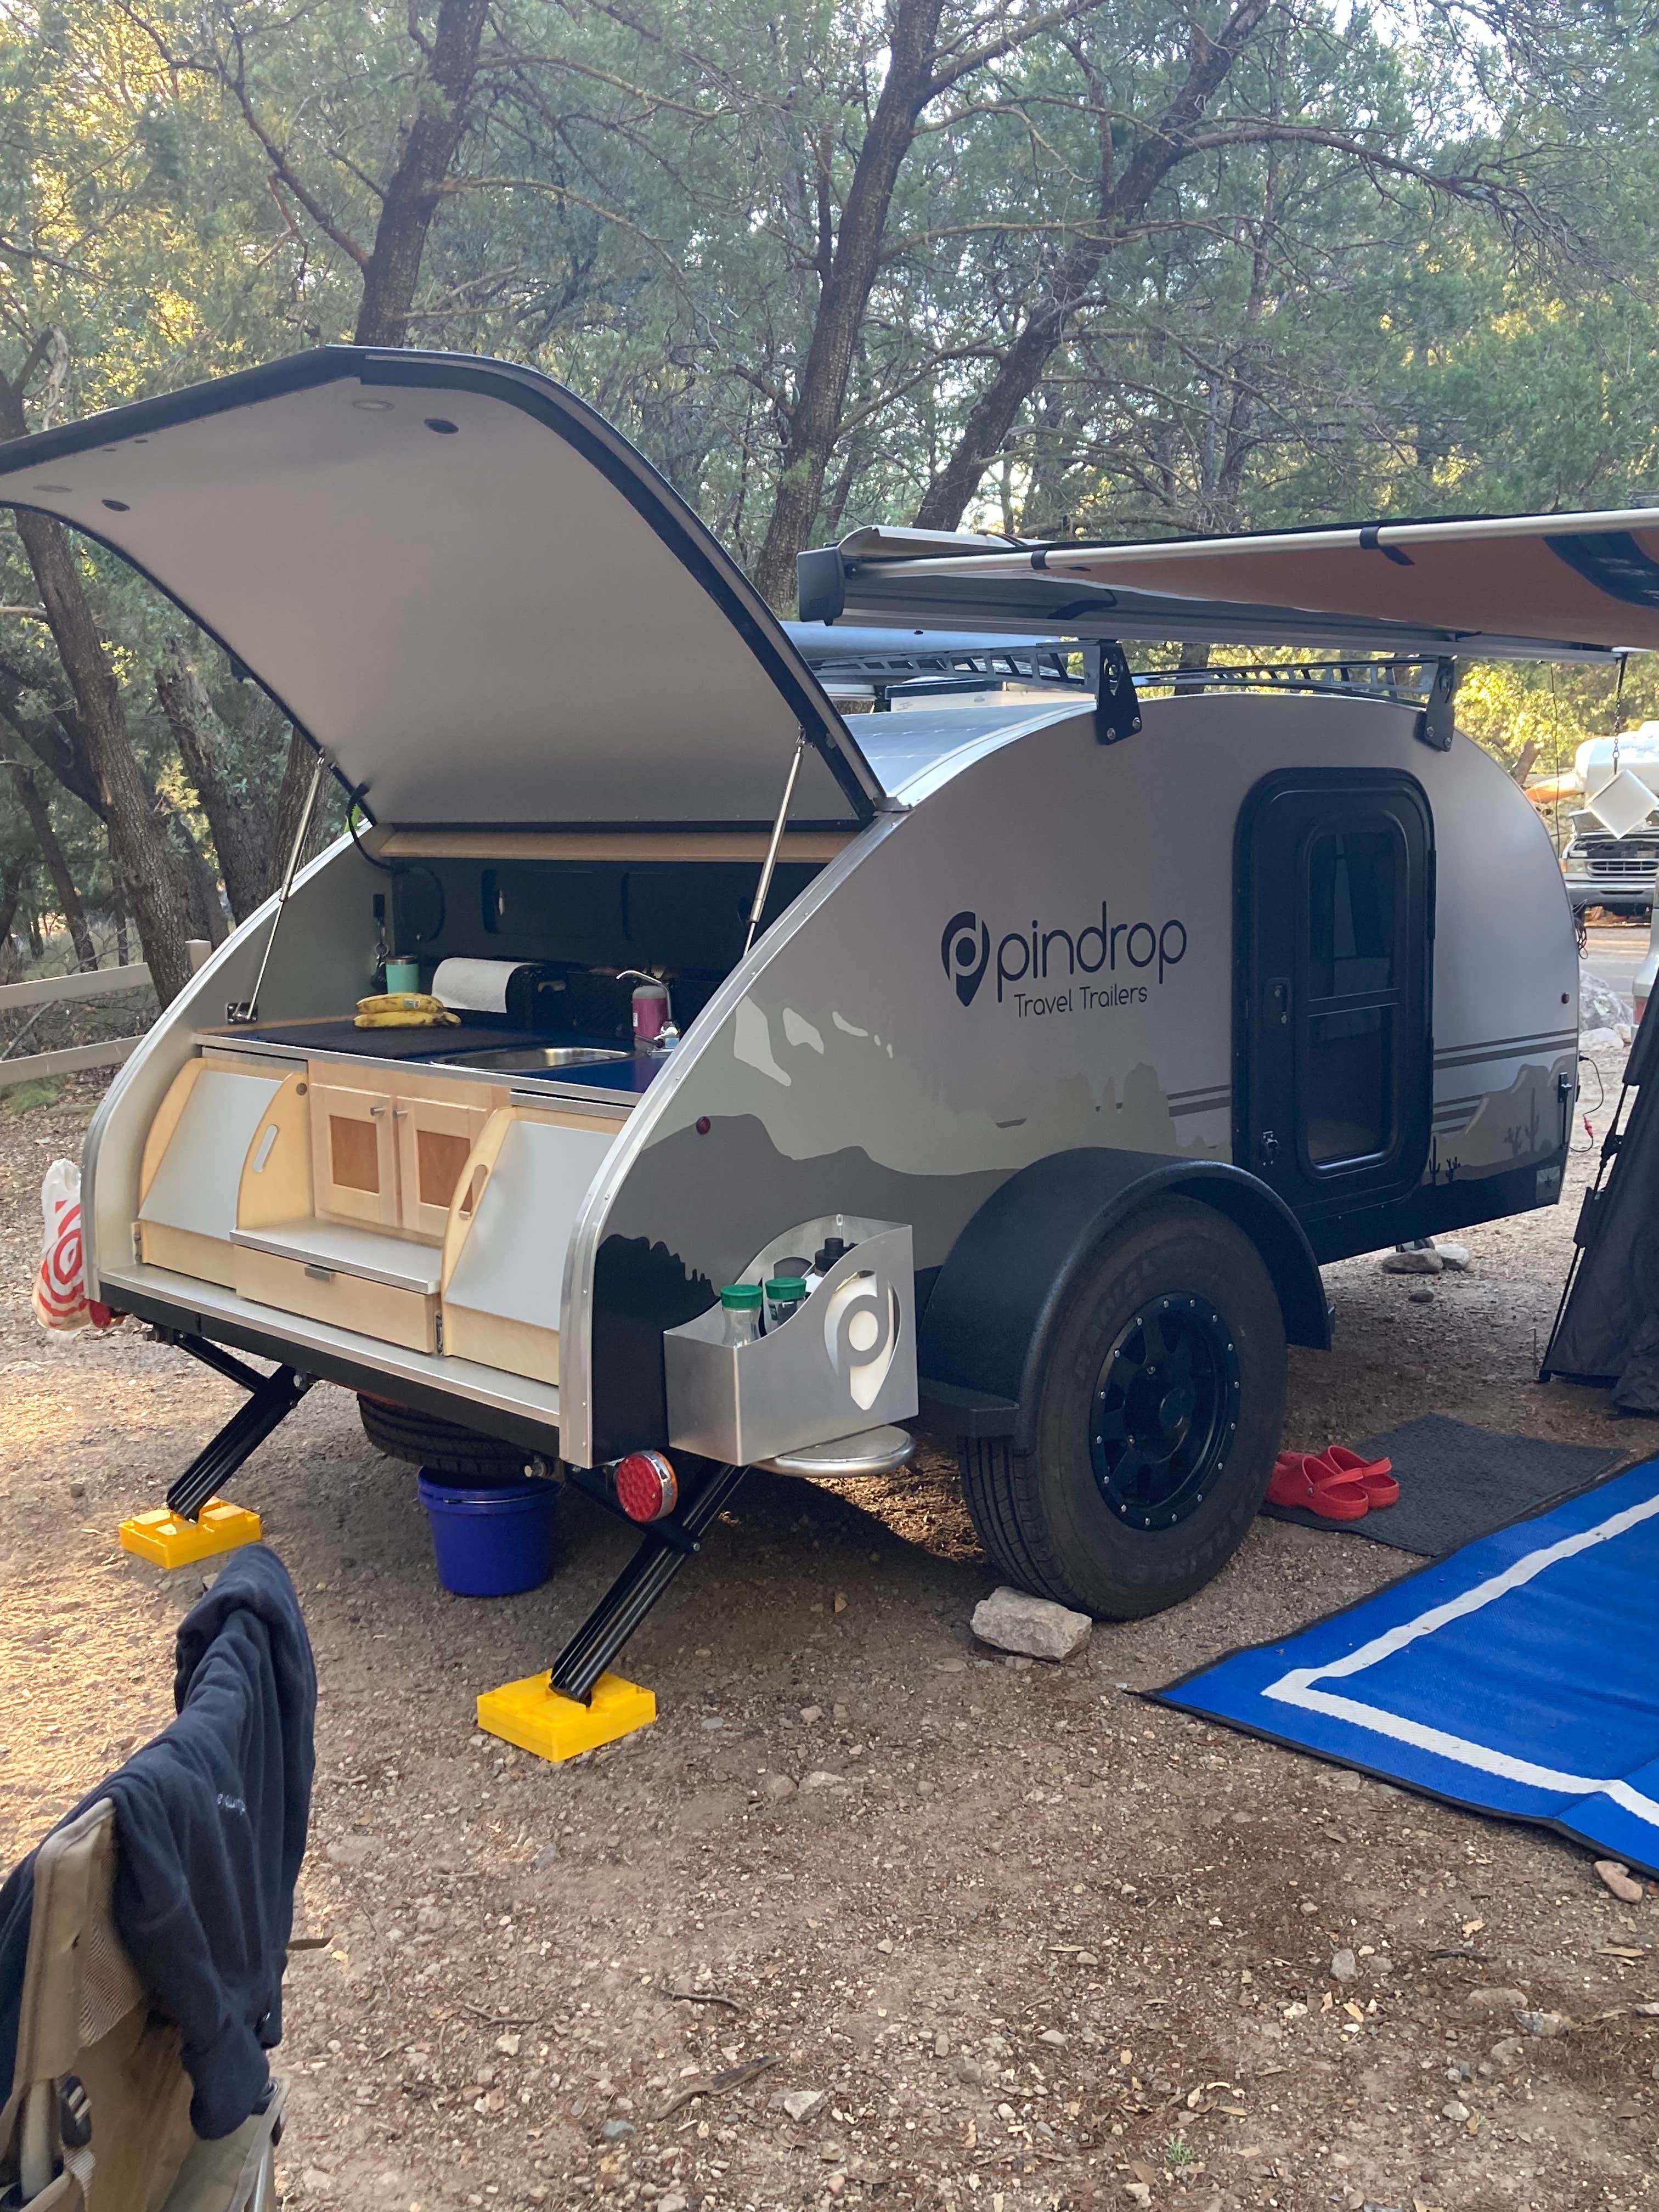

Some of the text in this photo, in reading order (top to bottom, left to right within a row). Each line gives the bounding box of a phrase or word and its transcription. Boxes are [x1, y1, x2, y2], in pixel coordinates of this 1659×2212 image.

[997, 900, 1187, 1003] pindrop
[1014, 984, 1148, 1018] Travel Trailers
